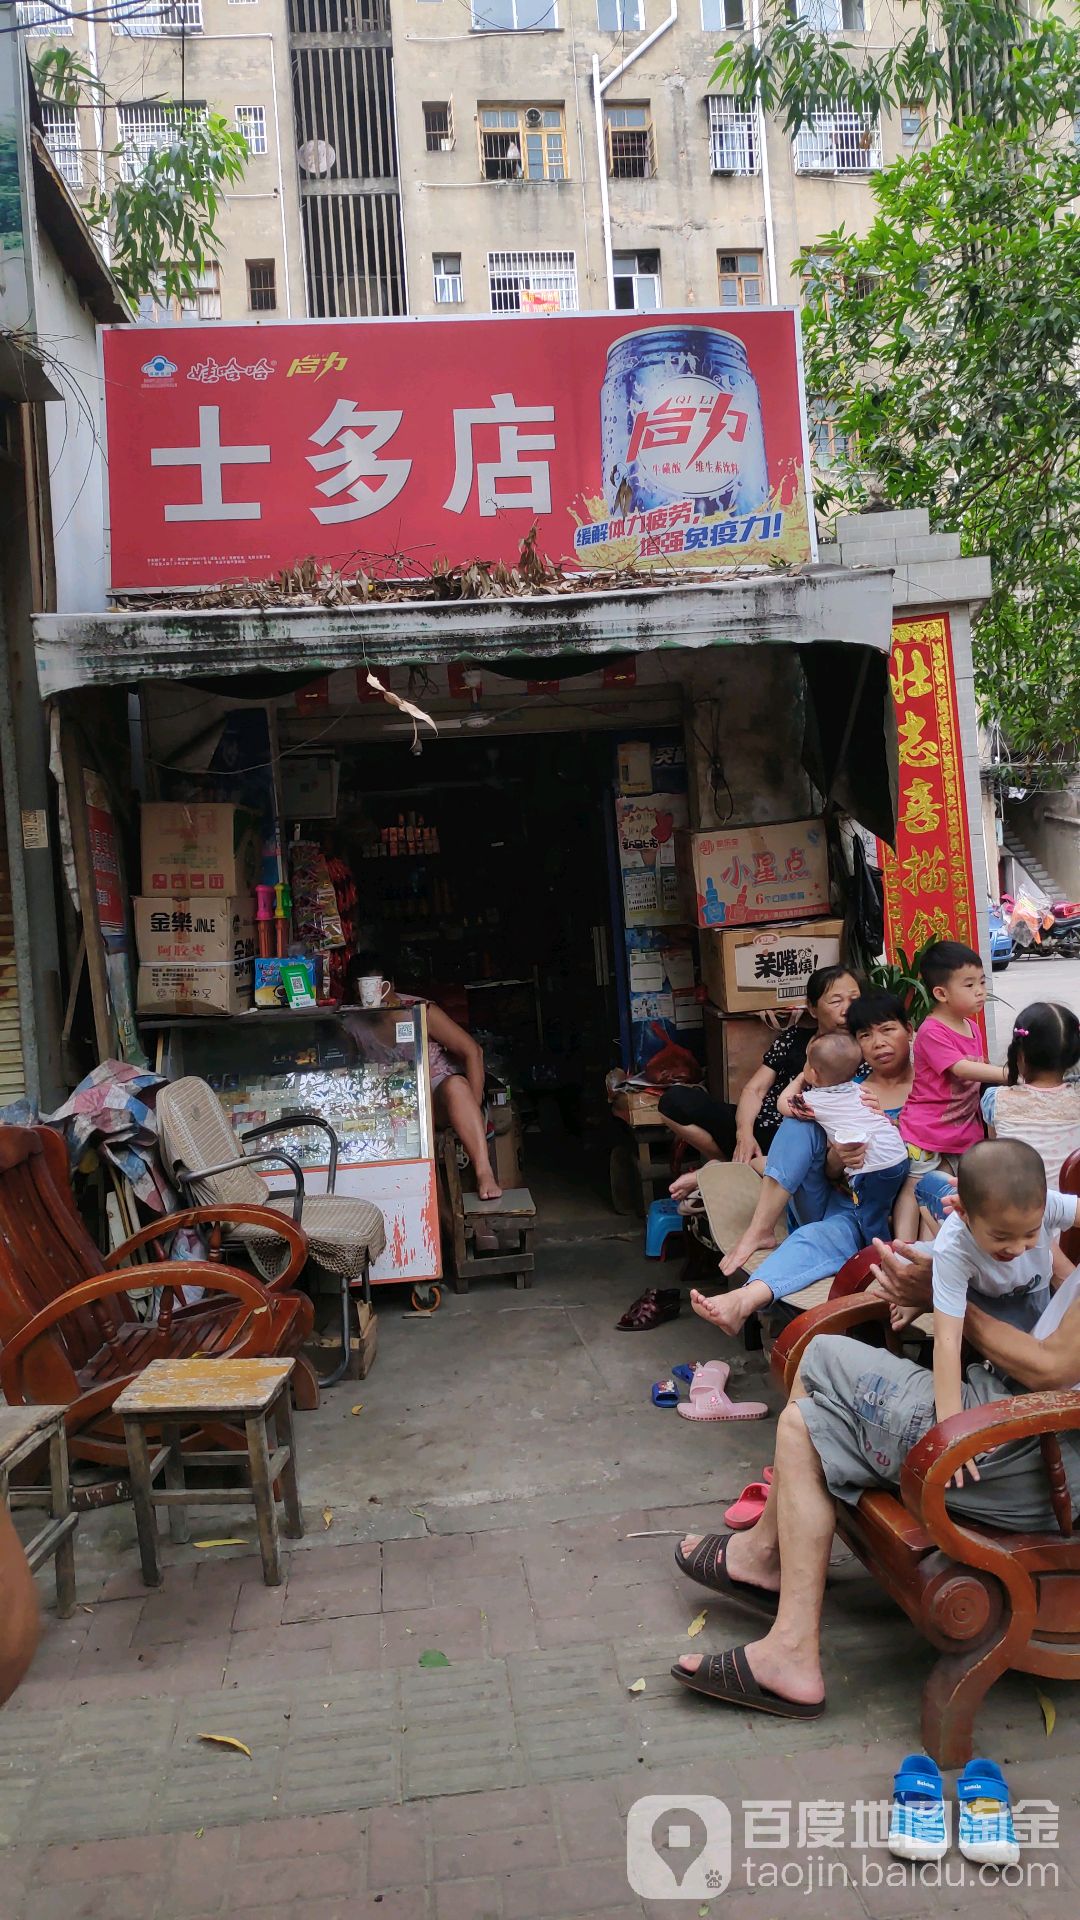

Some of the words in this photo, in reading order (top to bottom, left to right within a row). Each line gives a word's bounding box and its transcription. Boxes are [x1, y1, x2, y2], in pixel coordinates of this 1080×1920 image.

[187, 357, 275, 384] 娃哈哈
[286, 351, 349, 384] 启力
[626, 392, 749, 470] 启力
[151, 393, 556, 525] 士多店
[695, 461, 740, 476] 维生素饮料
[721, 847, 810, 889] 小星点
[194, 918, 216, 933] JINLE
